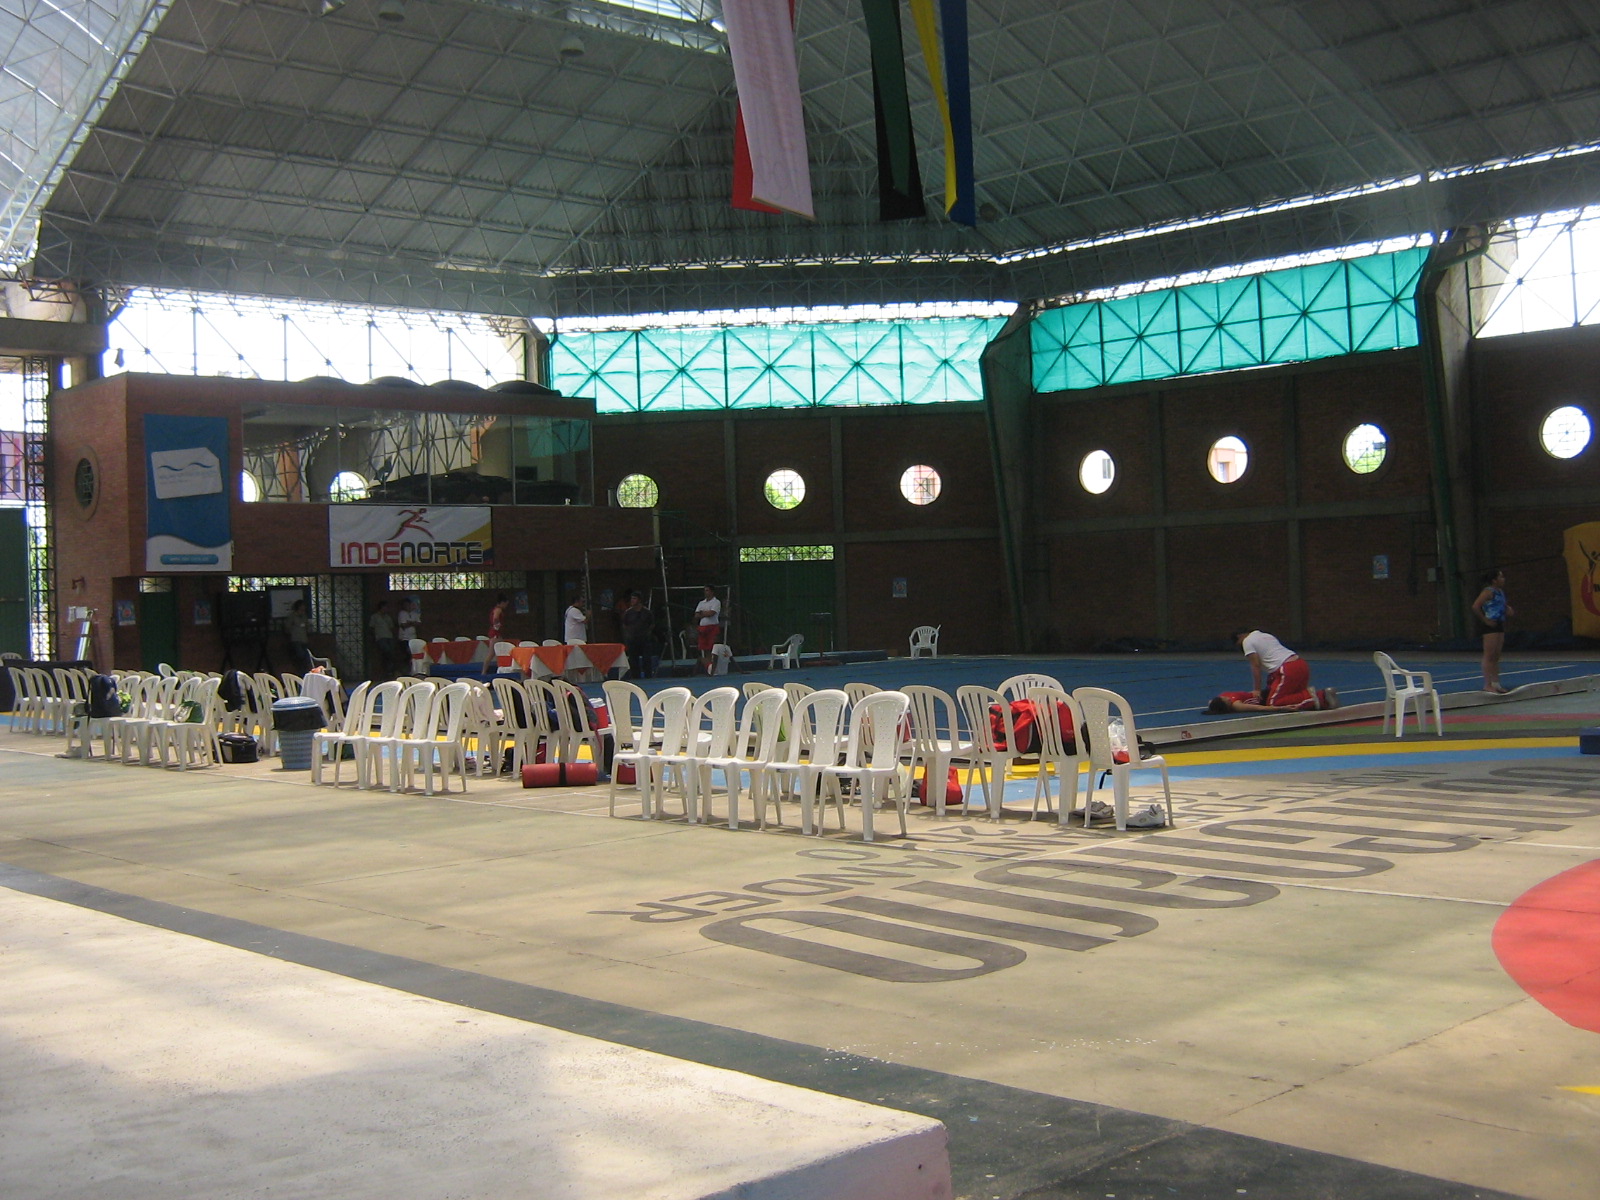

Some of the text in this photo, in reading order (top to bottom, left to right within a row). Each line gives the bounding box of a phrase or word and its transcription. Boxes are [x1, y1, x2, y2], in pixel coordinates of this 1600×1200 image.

[341, 541, 484, 565] INDENORTE
[1224, 769, 1448, 804] NORTE
[587, 827, 1117, 923] ANTANDER
